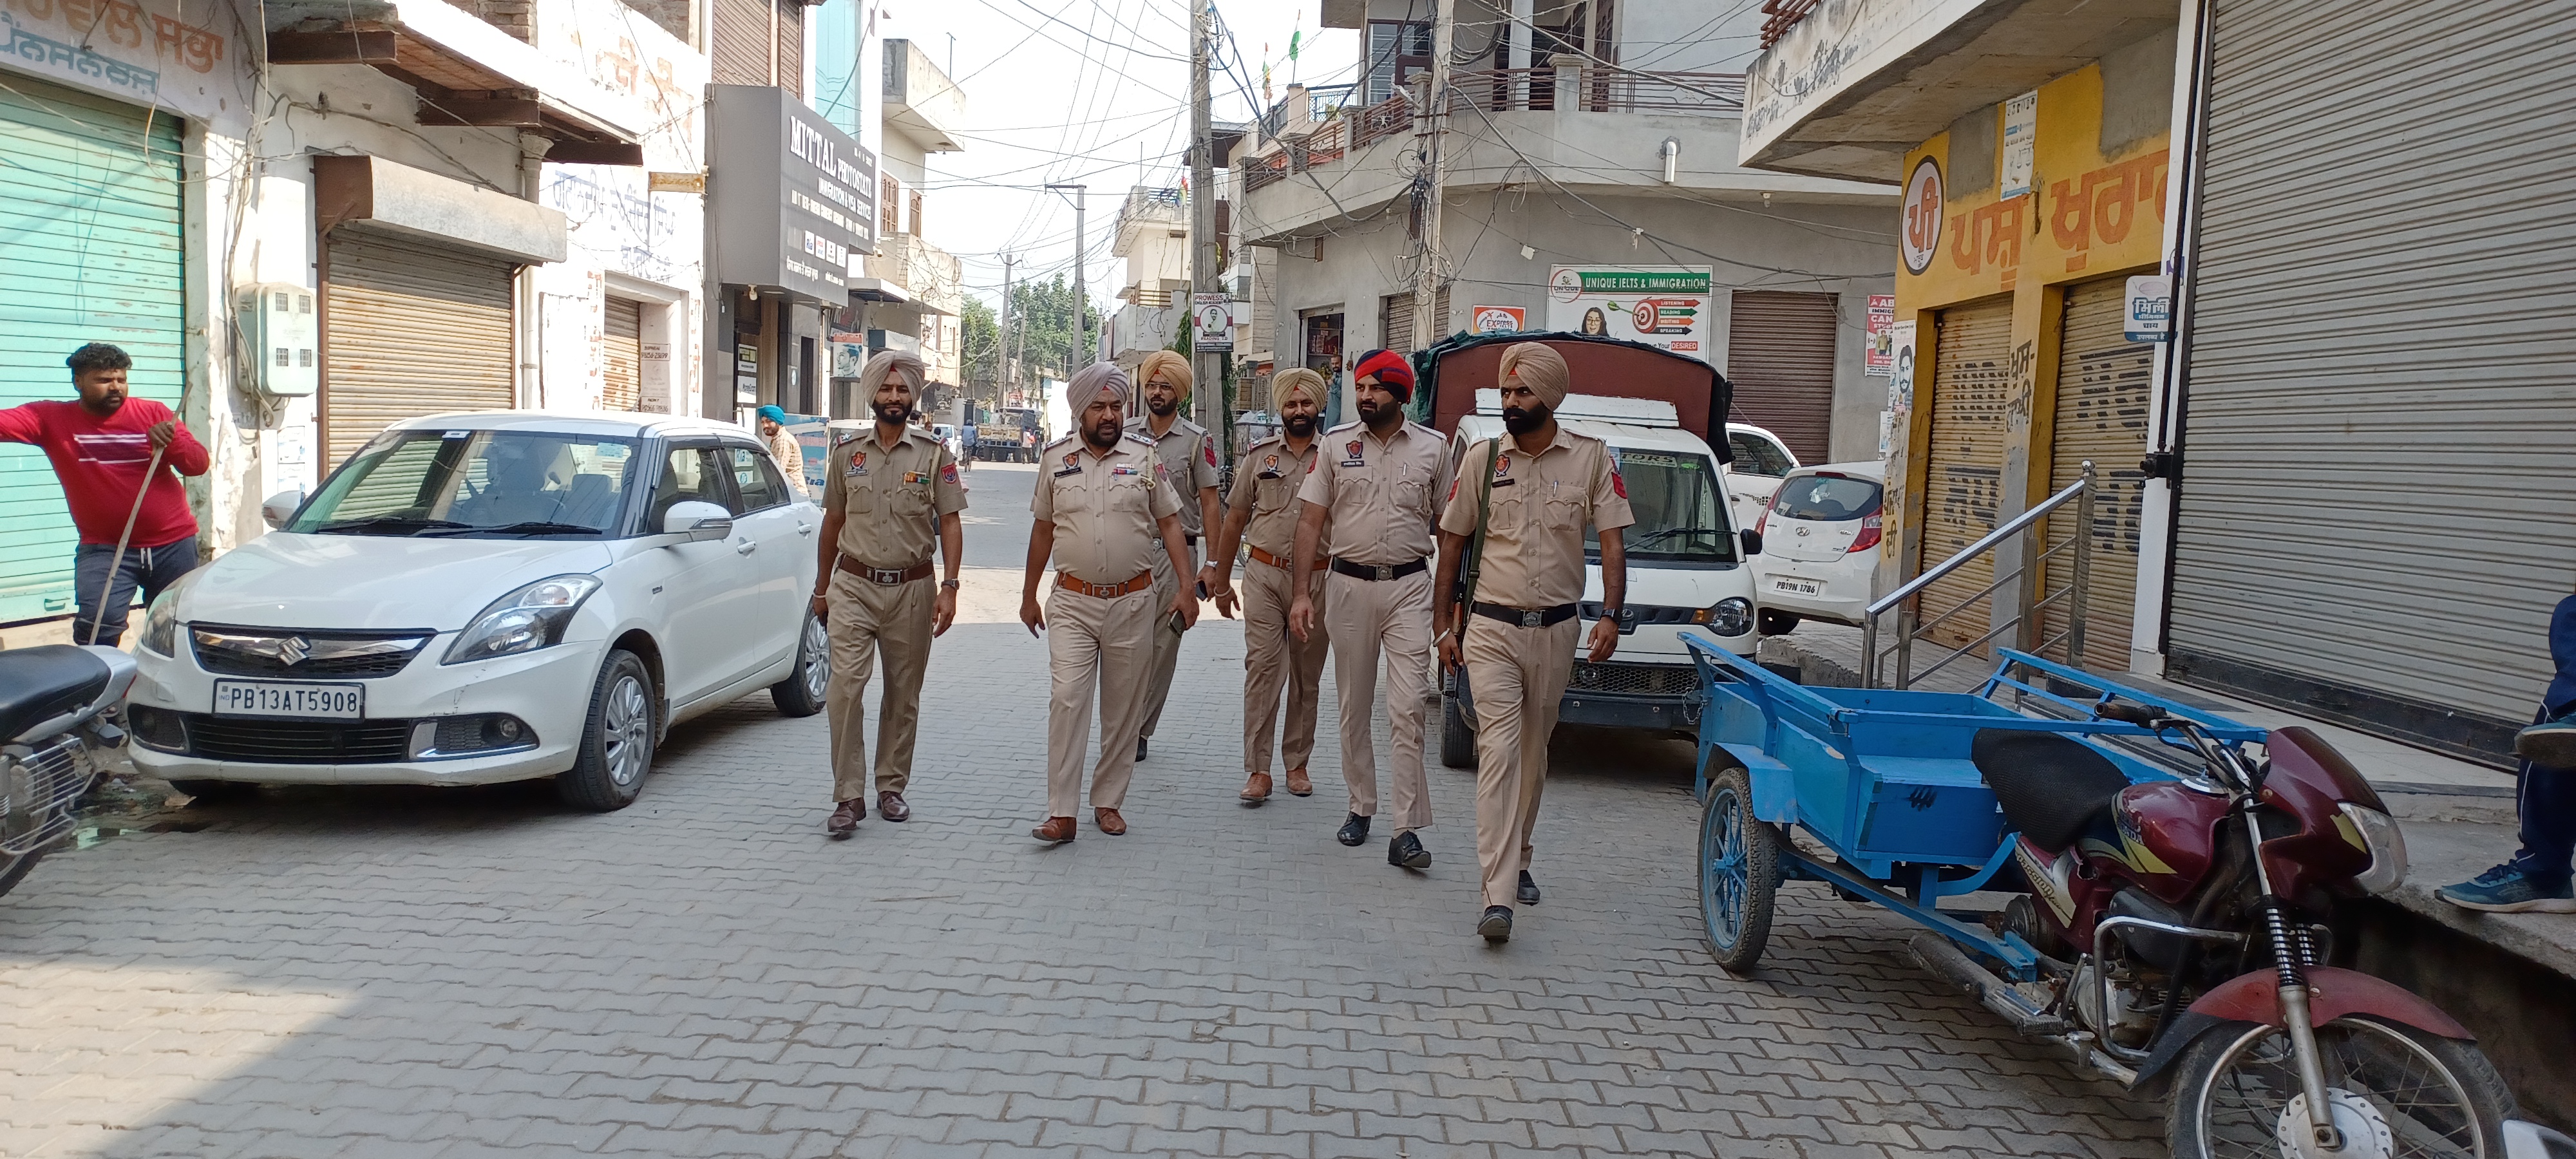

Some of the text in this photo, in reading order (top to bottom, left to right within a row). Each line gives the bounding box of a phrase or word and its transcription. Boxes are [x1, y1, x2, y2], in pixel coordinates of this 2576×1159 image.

[151, 12, 224, 73] ਸਭਾ
[790, 115, 872, 199] MITTAL PHOTOSTATE
[1909, 176, 1938, 253] ਪੀ
[1586, 278, 1706, 289] UNIQUE IELTS & IMMIGRATION
[2134, 299, 2171, 314] मिली
[2159, 331, 2165, 340] है
[1776, 581, 1815, 593] PB19N 1786
[231, 688, 357, 712] PB13AT5908
